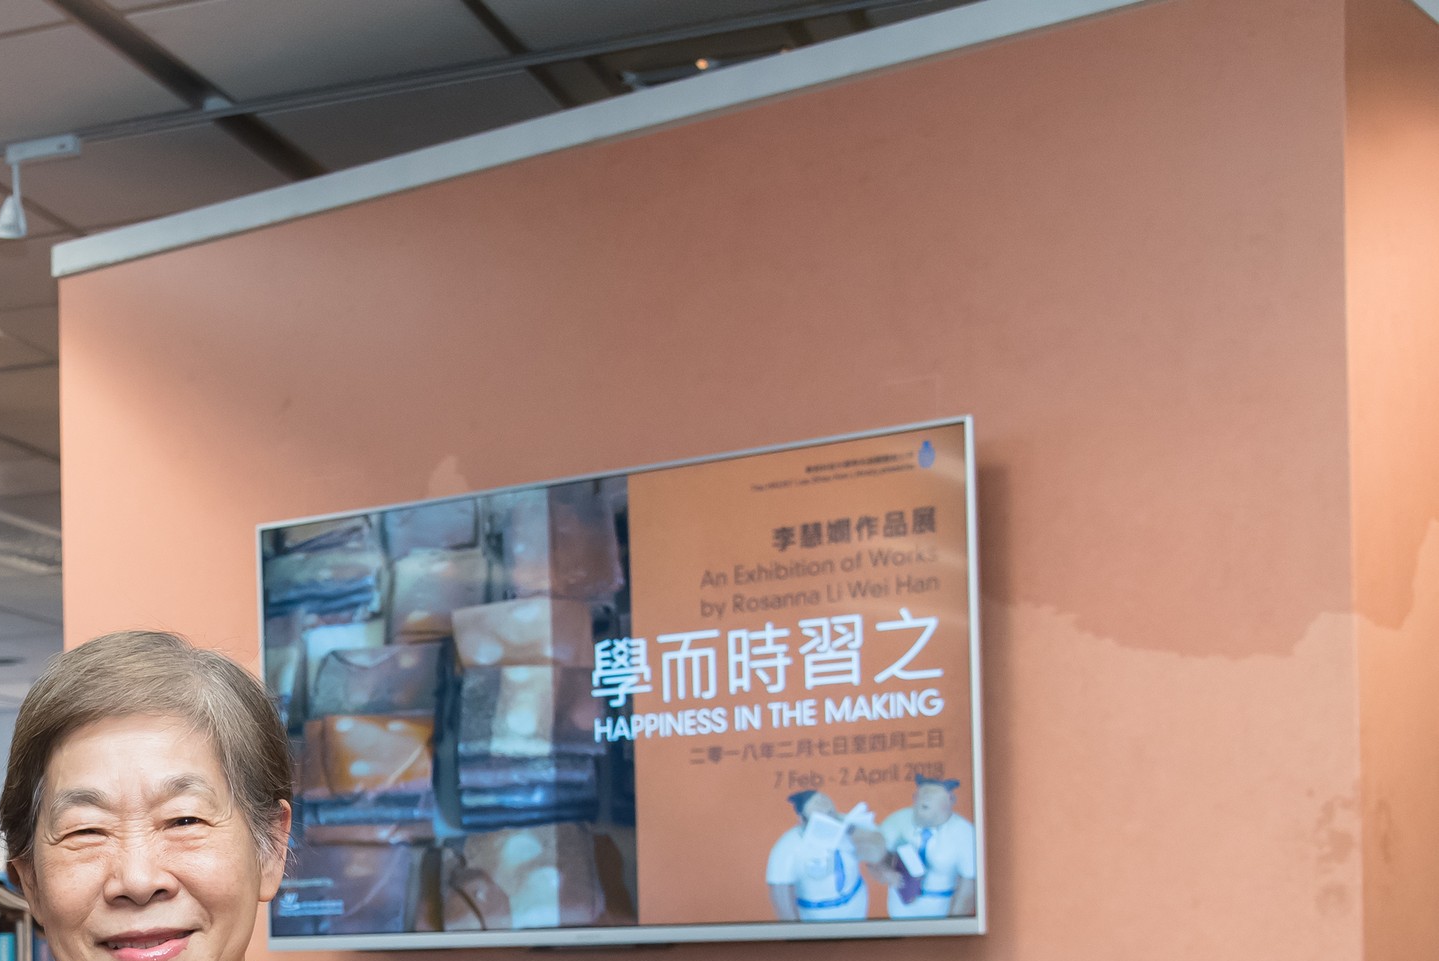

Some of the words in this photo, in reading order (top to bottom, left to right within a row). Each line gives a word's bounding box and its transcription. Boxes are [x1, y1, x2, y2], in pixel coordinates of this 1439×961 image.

[700, 569, 728, 588] An
[733, 557, 834, 585] Exhibition
[840, 553, 862, 573] of
[868, 544, 939, 568] Works
[700, 598, 726, 620] by
[732, 588, 820, 612] Rosanna
[826, 584, 843, 601] Li
[847, 577, 888, 599] Wei
[896, 574, 941, 595] Han
[590, 607, 945, 708] 學而時習之
[593, 706, 728, 743] HAPPINESS
[734, 702, 761, 731] IN
[768, 698, 818, 728] THE
[824, 688, 945, 724] MAKING
[774, 771, 784, 788] 7
[788, 768, 824, 789] Feb
[839, 767, 850, 786] 2
[853, 765, 898, 785] April
